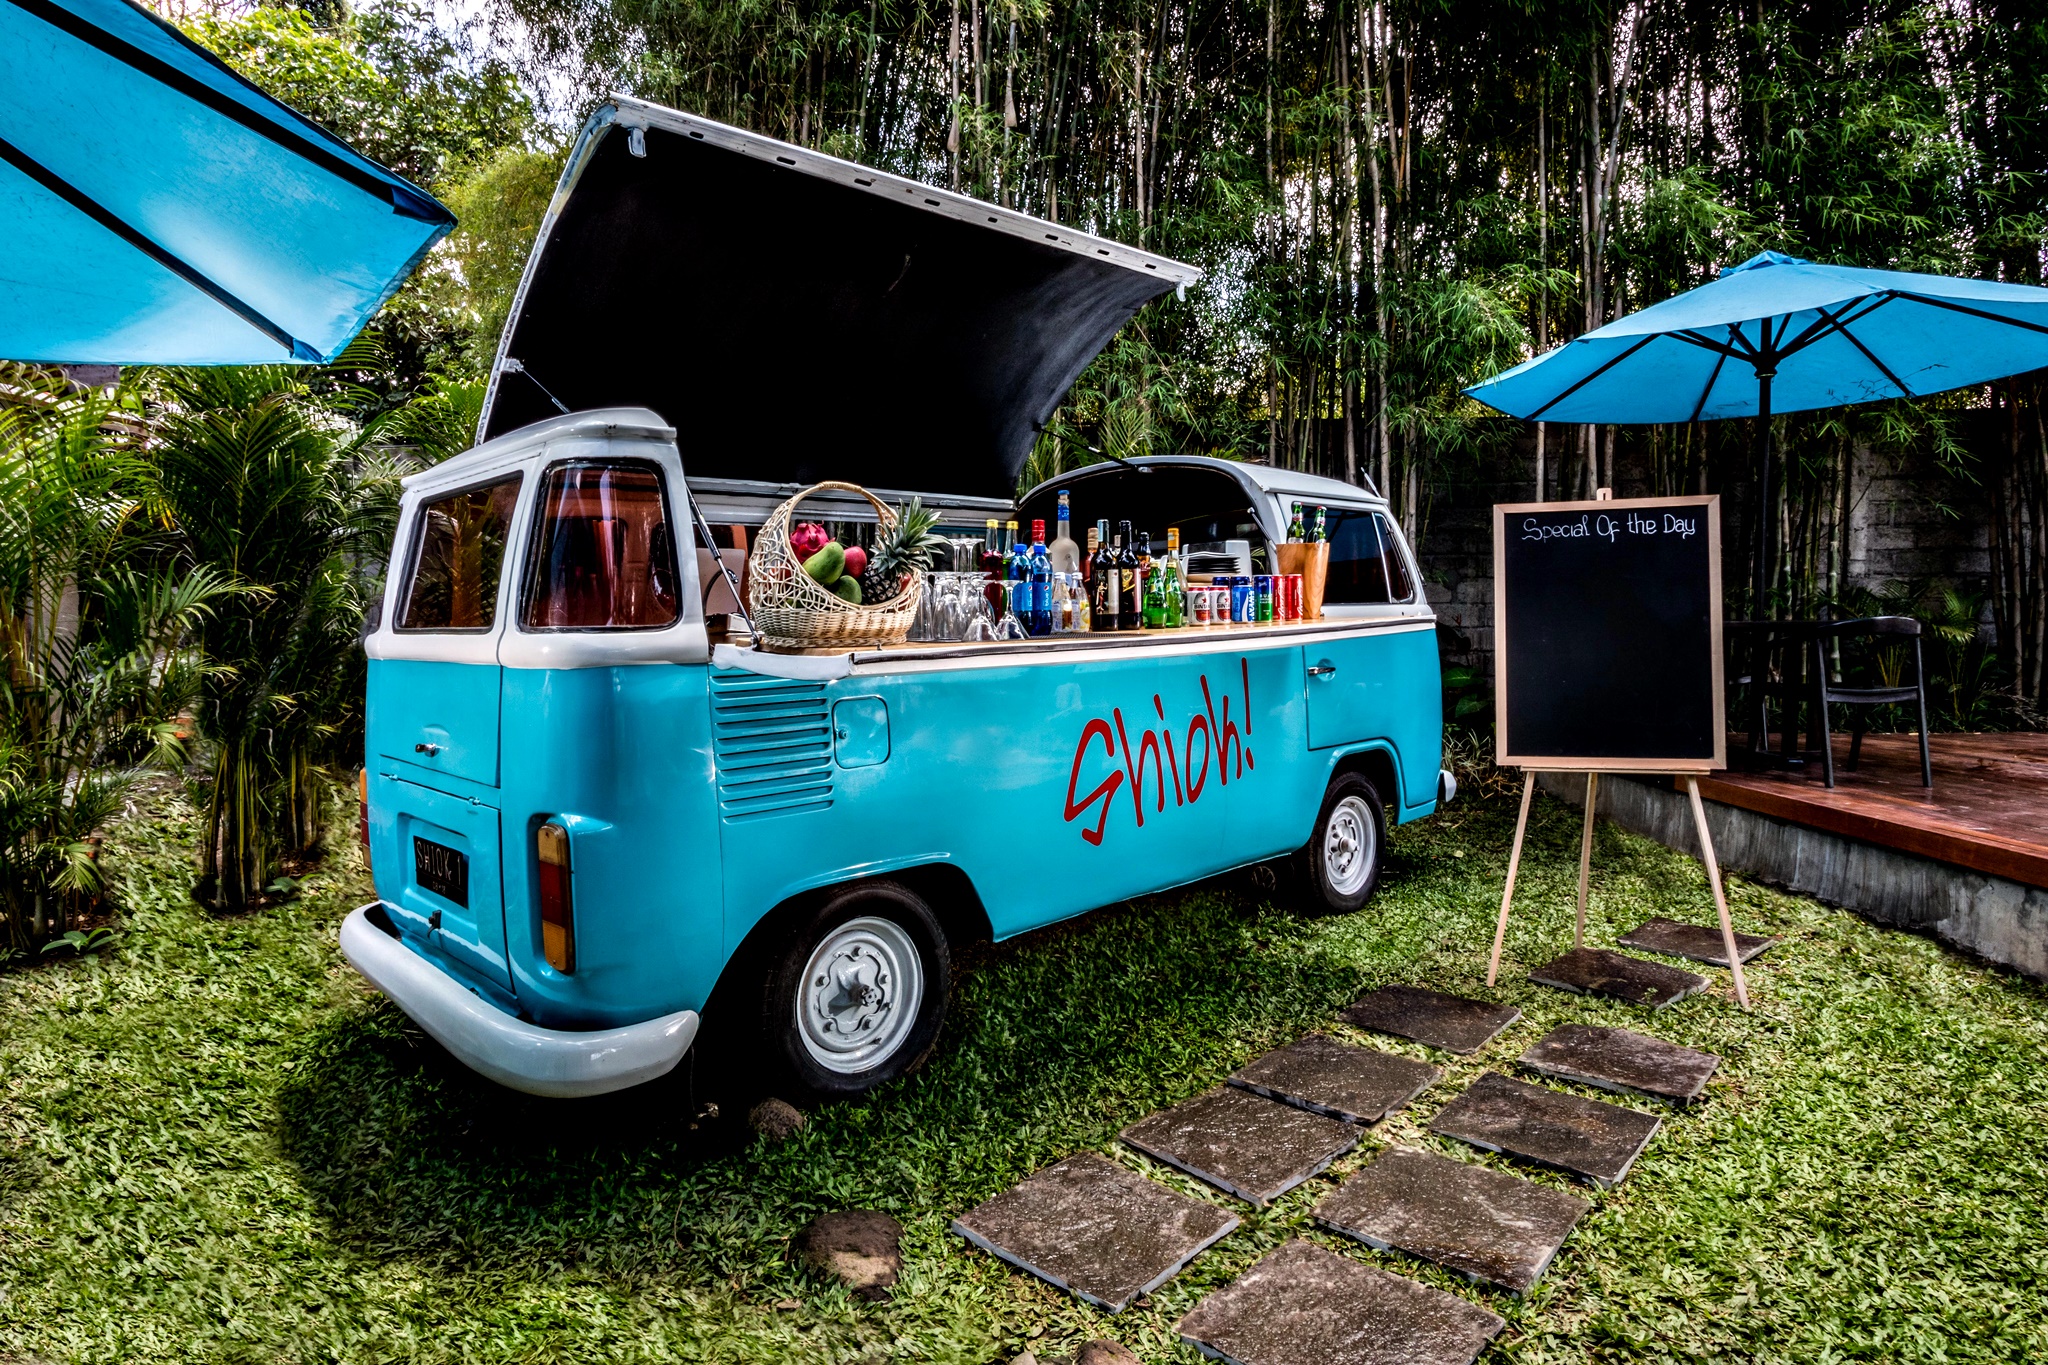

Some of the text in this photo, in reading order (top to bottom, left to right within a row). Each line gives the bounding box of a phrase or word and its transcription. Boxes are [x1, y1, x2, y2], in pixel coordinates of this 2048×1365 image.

[1521, 512, 1696, 543] Special Of the Day
[416, 840, 452, 881] SHIOK
